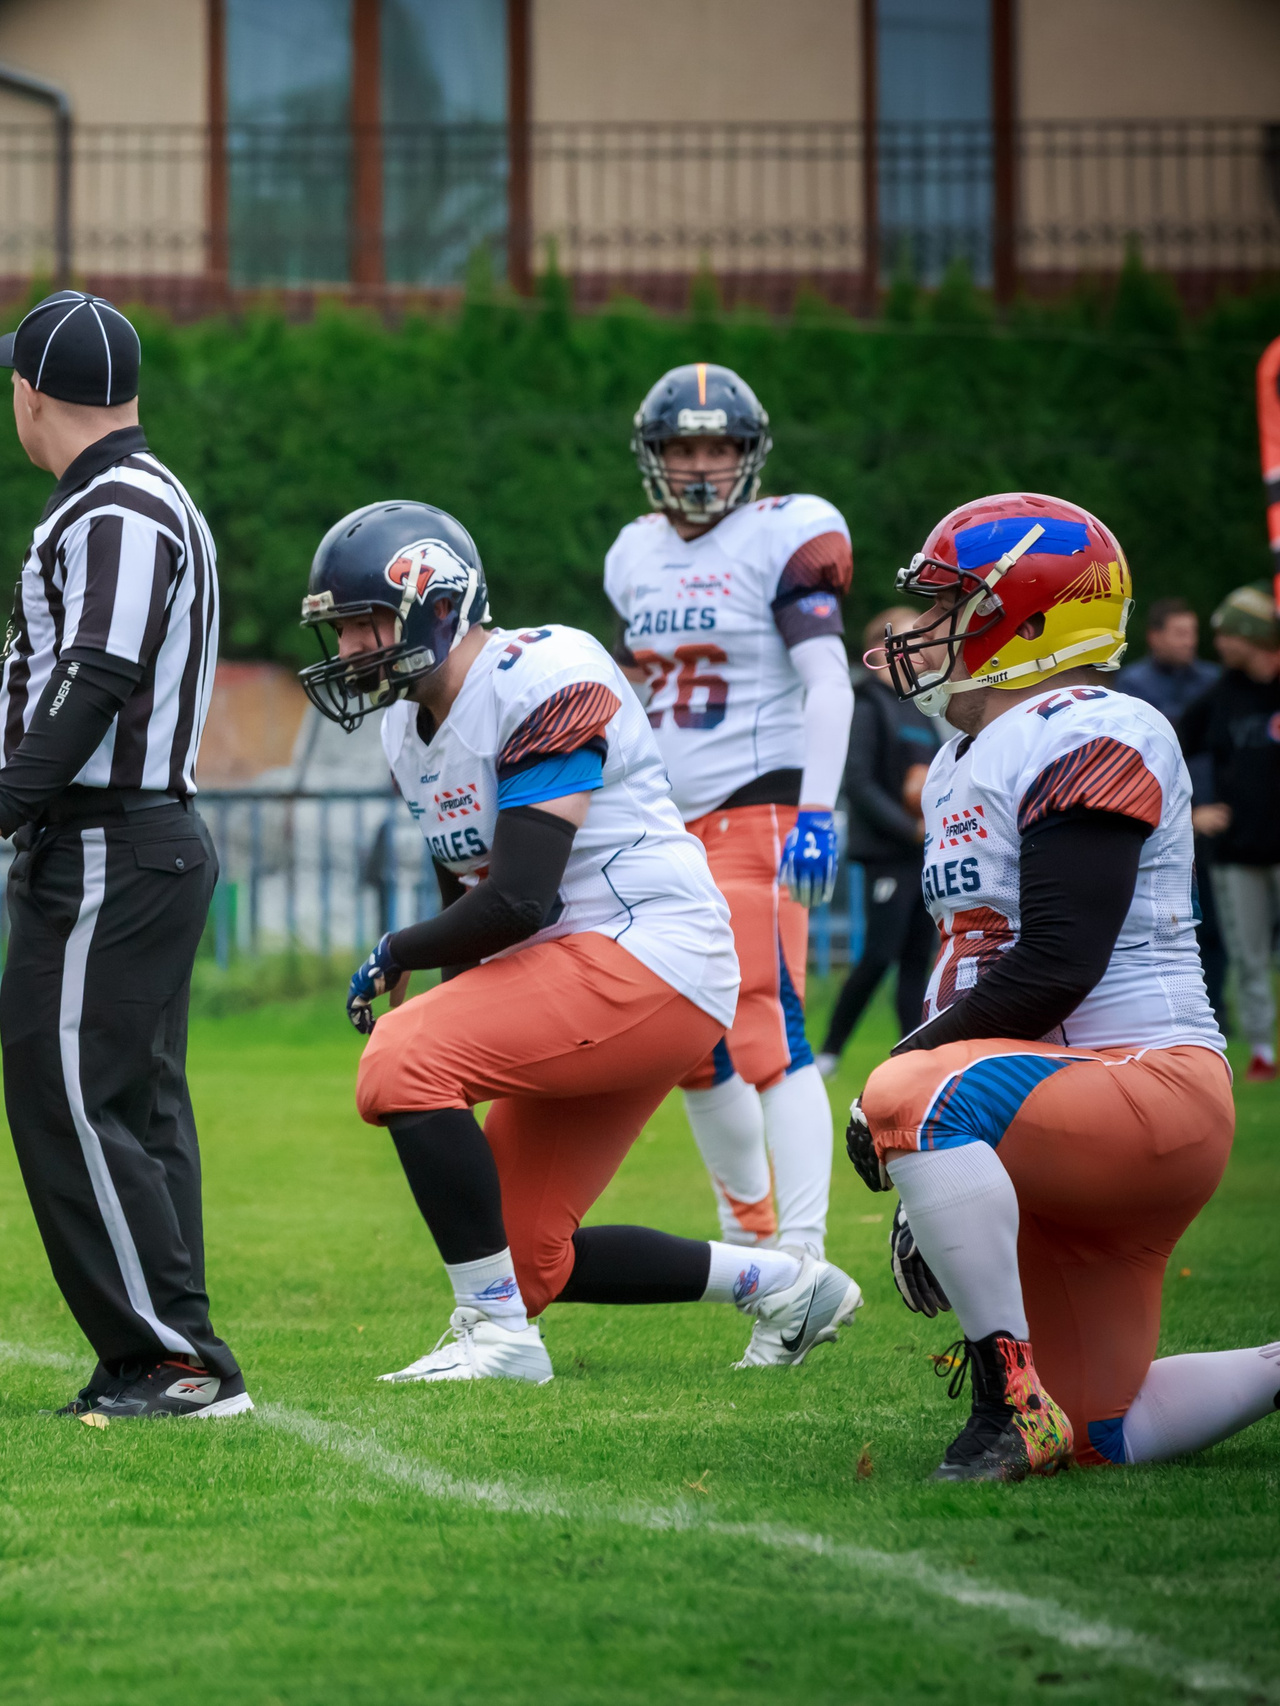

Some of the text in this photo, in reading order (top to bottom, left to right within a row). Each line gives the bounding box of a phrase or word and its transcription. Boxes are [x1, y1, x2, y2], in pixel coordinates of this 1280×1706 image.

[976, 671, 1009, 684] hutt
[947, 817, 979, 838] FRIDAYS
[425, 826, 489, 864] GLES
[922, 856, 981, 909] GLES
